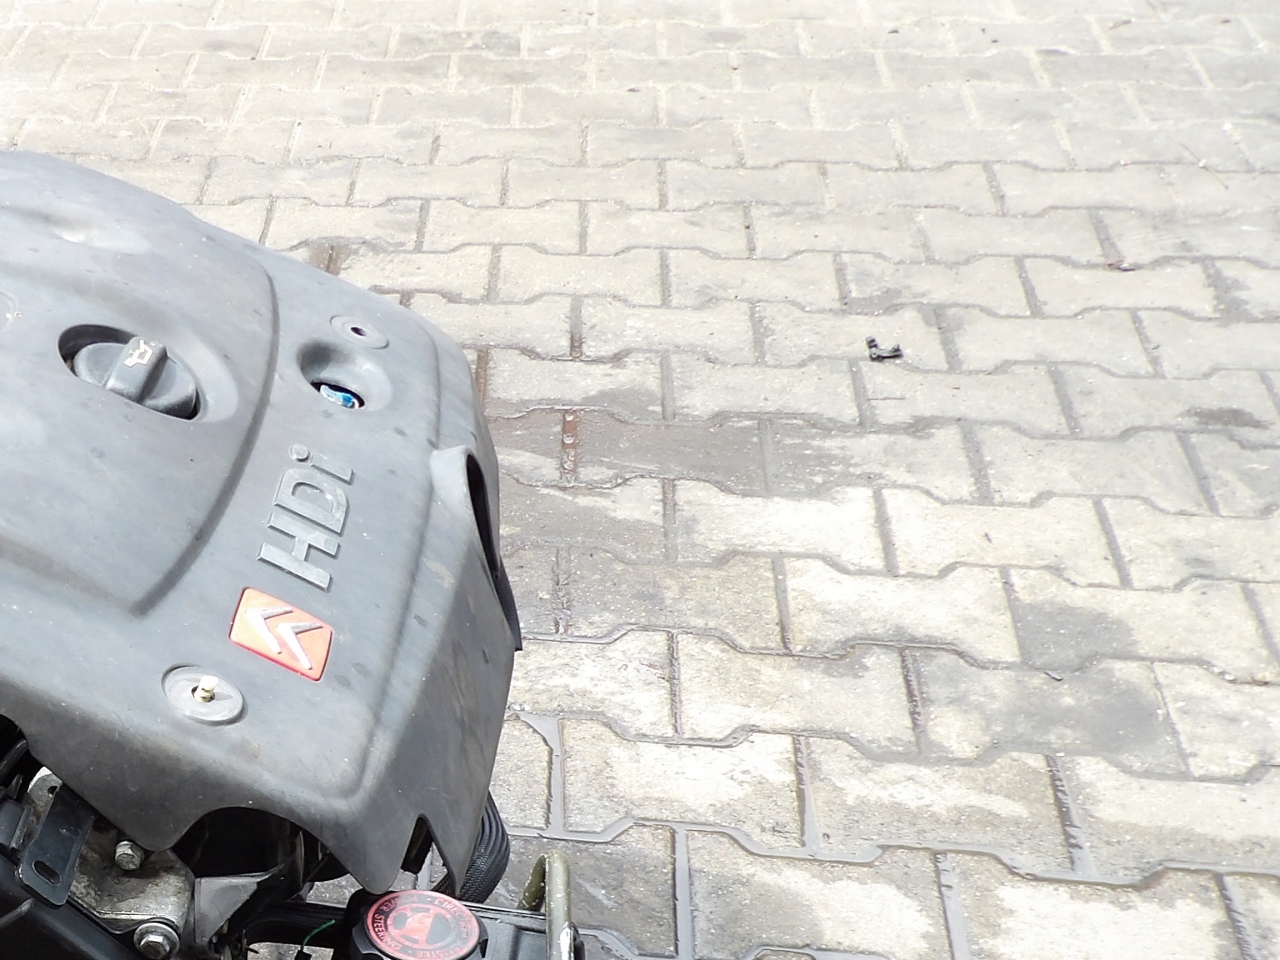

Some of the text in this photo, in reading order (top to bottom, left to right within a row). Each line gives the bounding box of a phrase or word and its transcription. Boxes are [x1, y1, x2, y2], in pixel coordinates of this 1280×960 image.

[256, 442, 354, 592] HDi
[373, 913, 402, 951] STEERING
[434, 897, 472, 939] DIRECON
